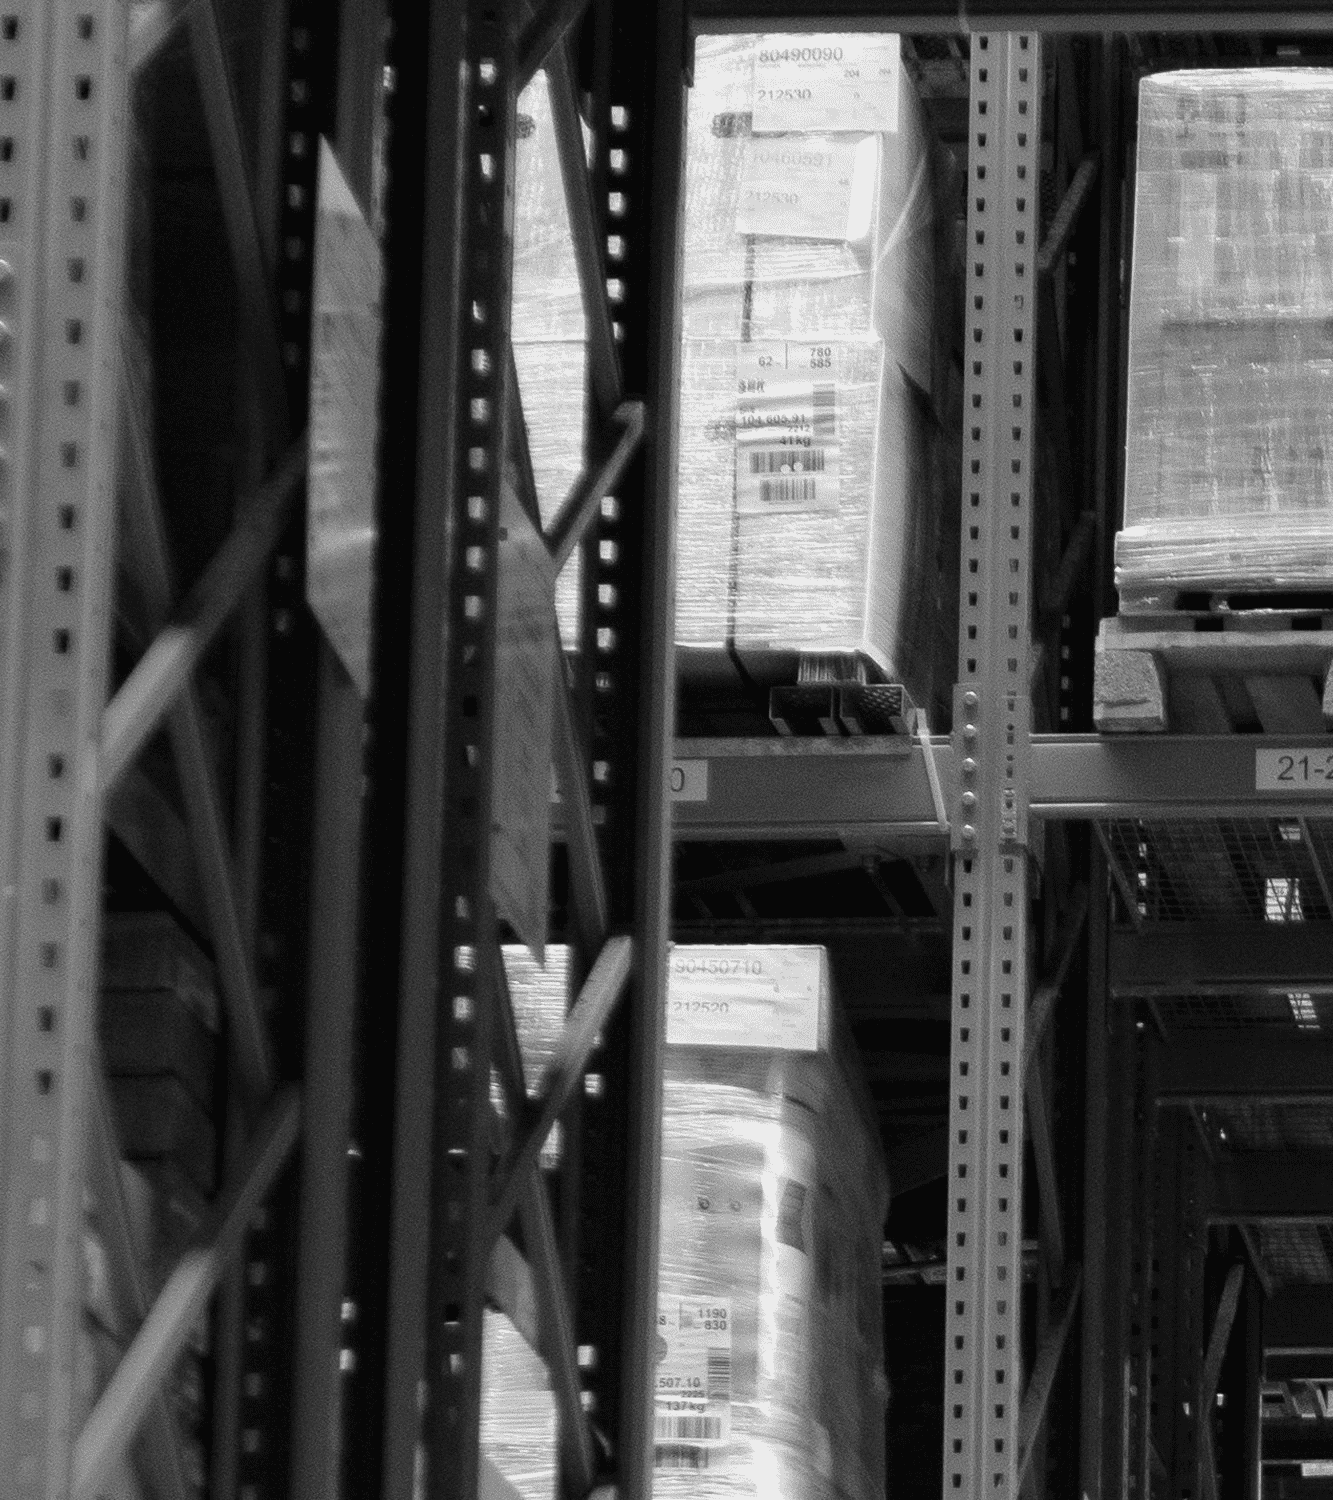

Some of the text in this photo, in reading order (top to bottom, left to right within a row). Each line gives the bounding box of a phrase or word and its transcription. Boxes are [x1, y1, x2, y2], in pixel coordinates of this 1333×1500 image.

[759, 47, 844, 62] 80490090
[757, 88, 812, 100] 212530
[810, 347, 832, 357] 780
[758, 356, 773, 367] 62
[698, 1308, 727, 1319] 1190
[704, 1320, 728, 1331] 830
